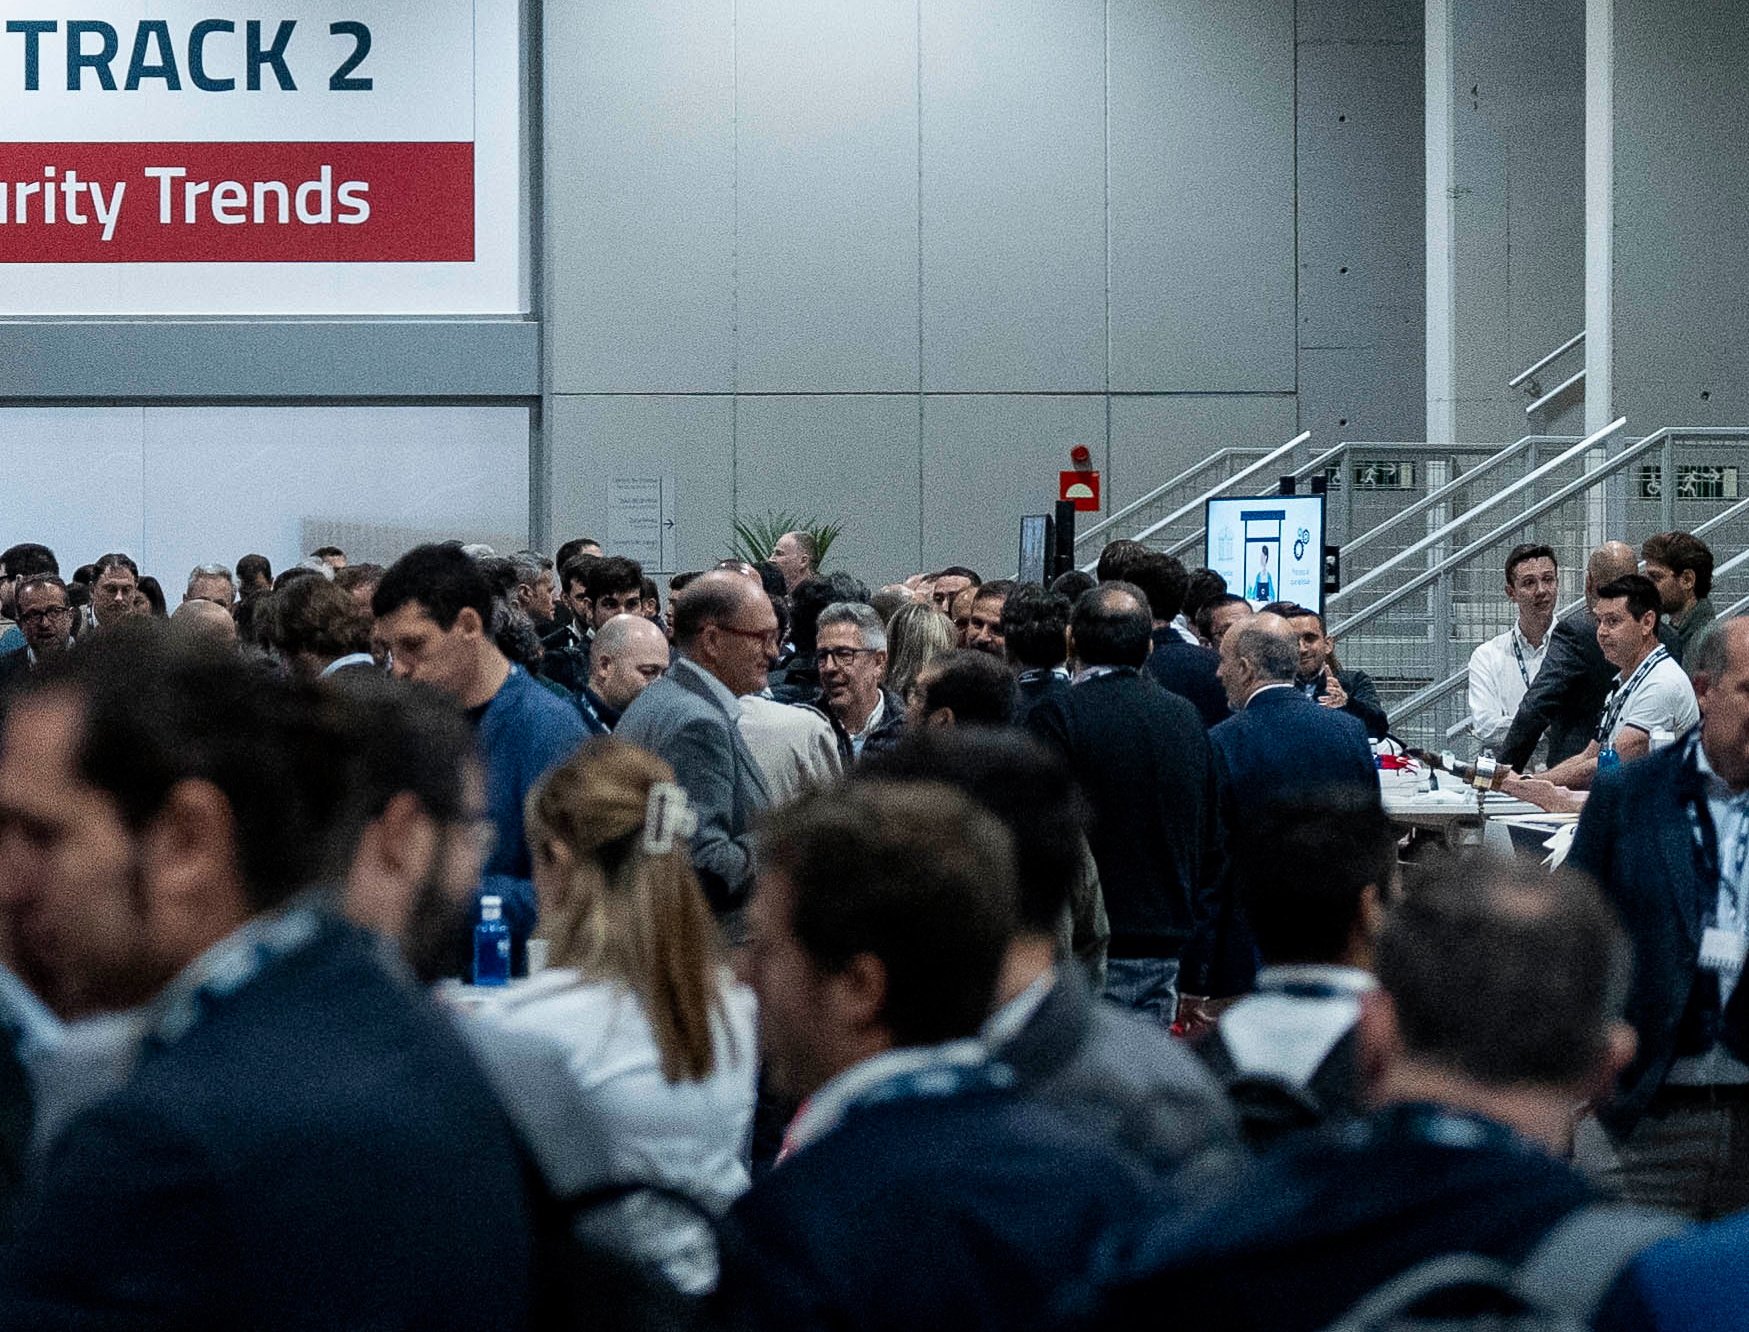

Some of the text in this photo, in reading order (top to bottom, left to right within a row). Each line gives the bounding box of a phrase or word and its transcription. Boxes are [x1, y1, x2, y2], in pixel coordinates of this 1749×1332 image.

[6, 18, 374, 93] TRACK 2
[144, 164, 371, 226] Trends
